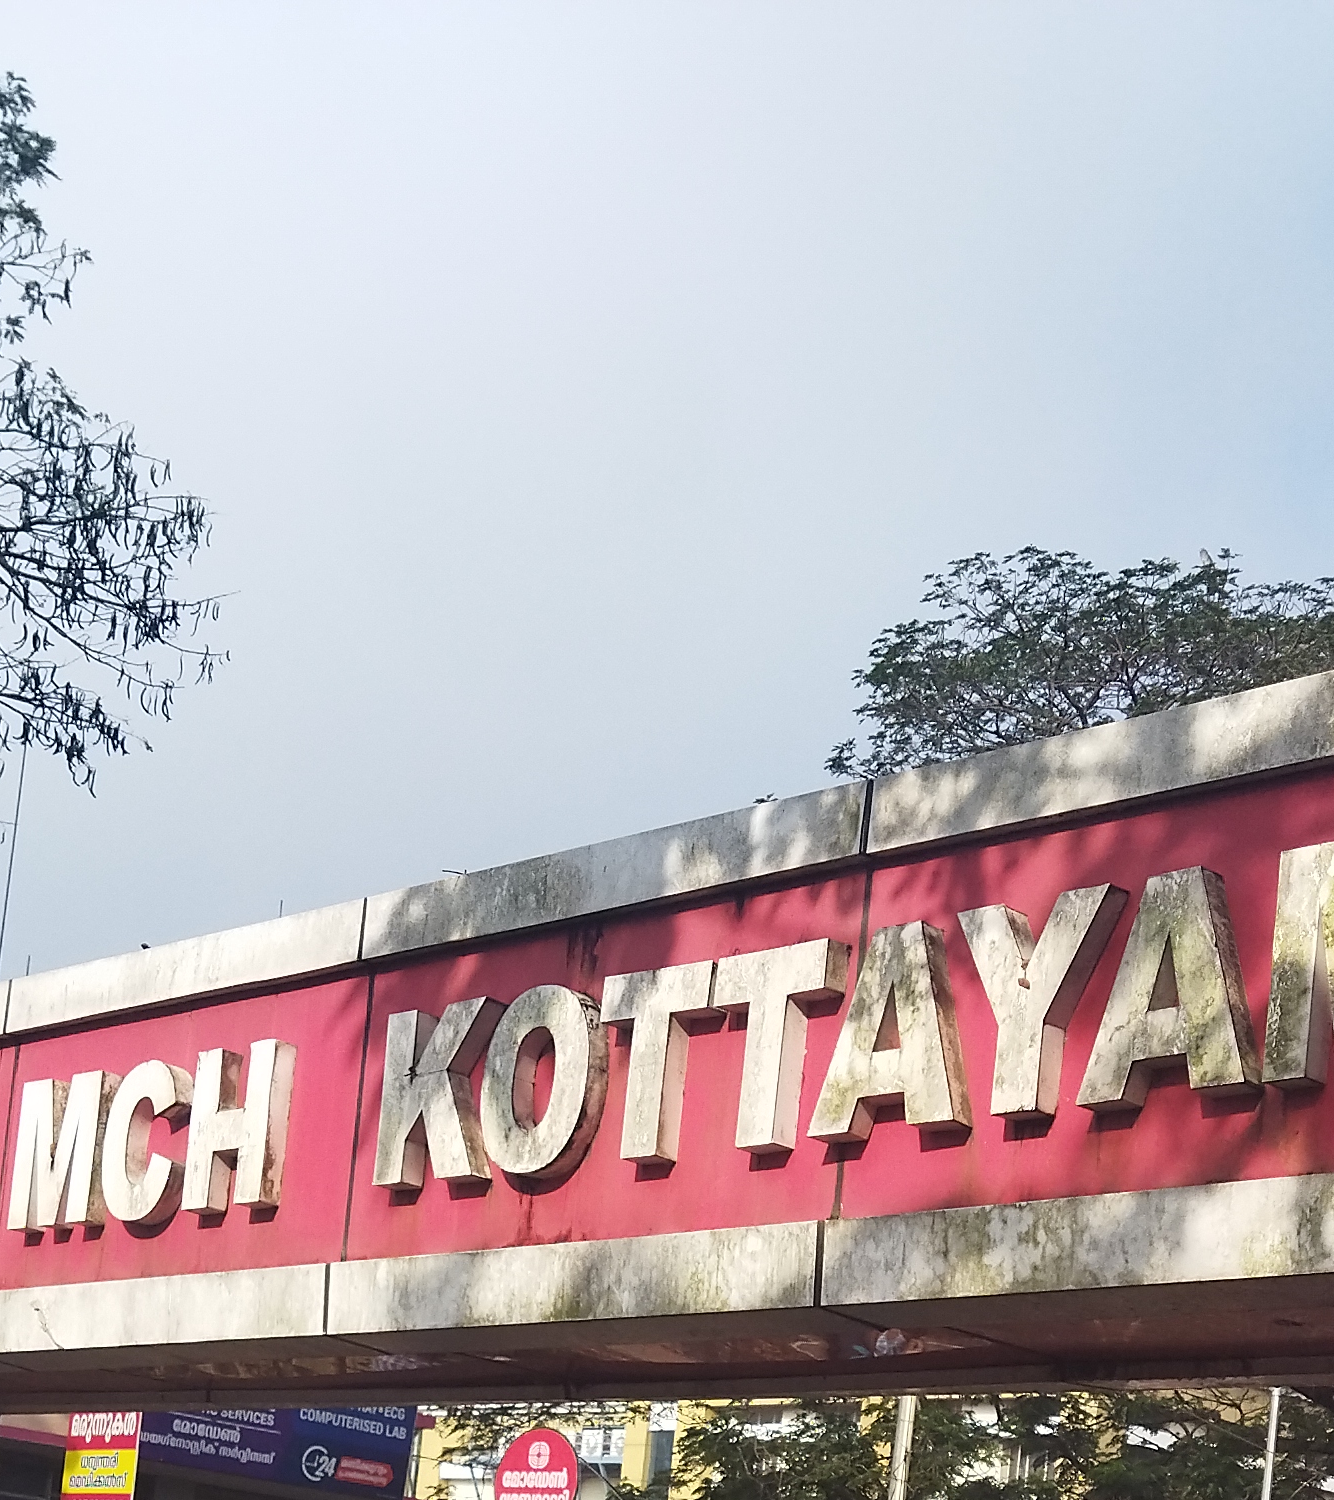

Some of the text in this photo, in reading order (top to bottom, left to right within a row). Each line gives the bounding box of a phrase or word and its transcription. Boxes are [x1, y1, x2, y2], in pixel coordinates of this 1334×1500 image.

[7, 1039, 296, 1236] MCH
[71, 1411, 137, 1443] മരുന്നുകൾ
[300, 1408, 407, 1440] COMPUTERISED LAB
[315, 1456, 337, 1477] 24
[502, 1468, 568, 1489] മോഡേൺ
